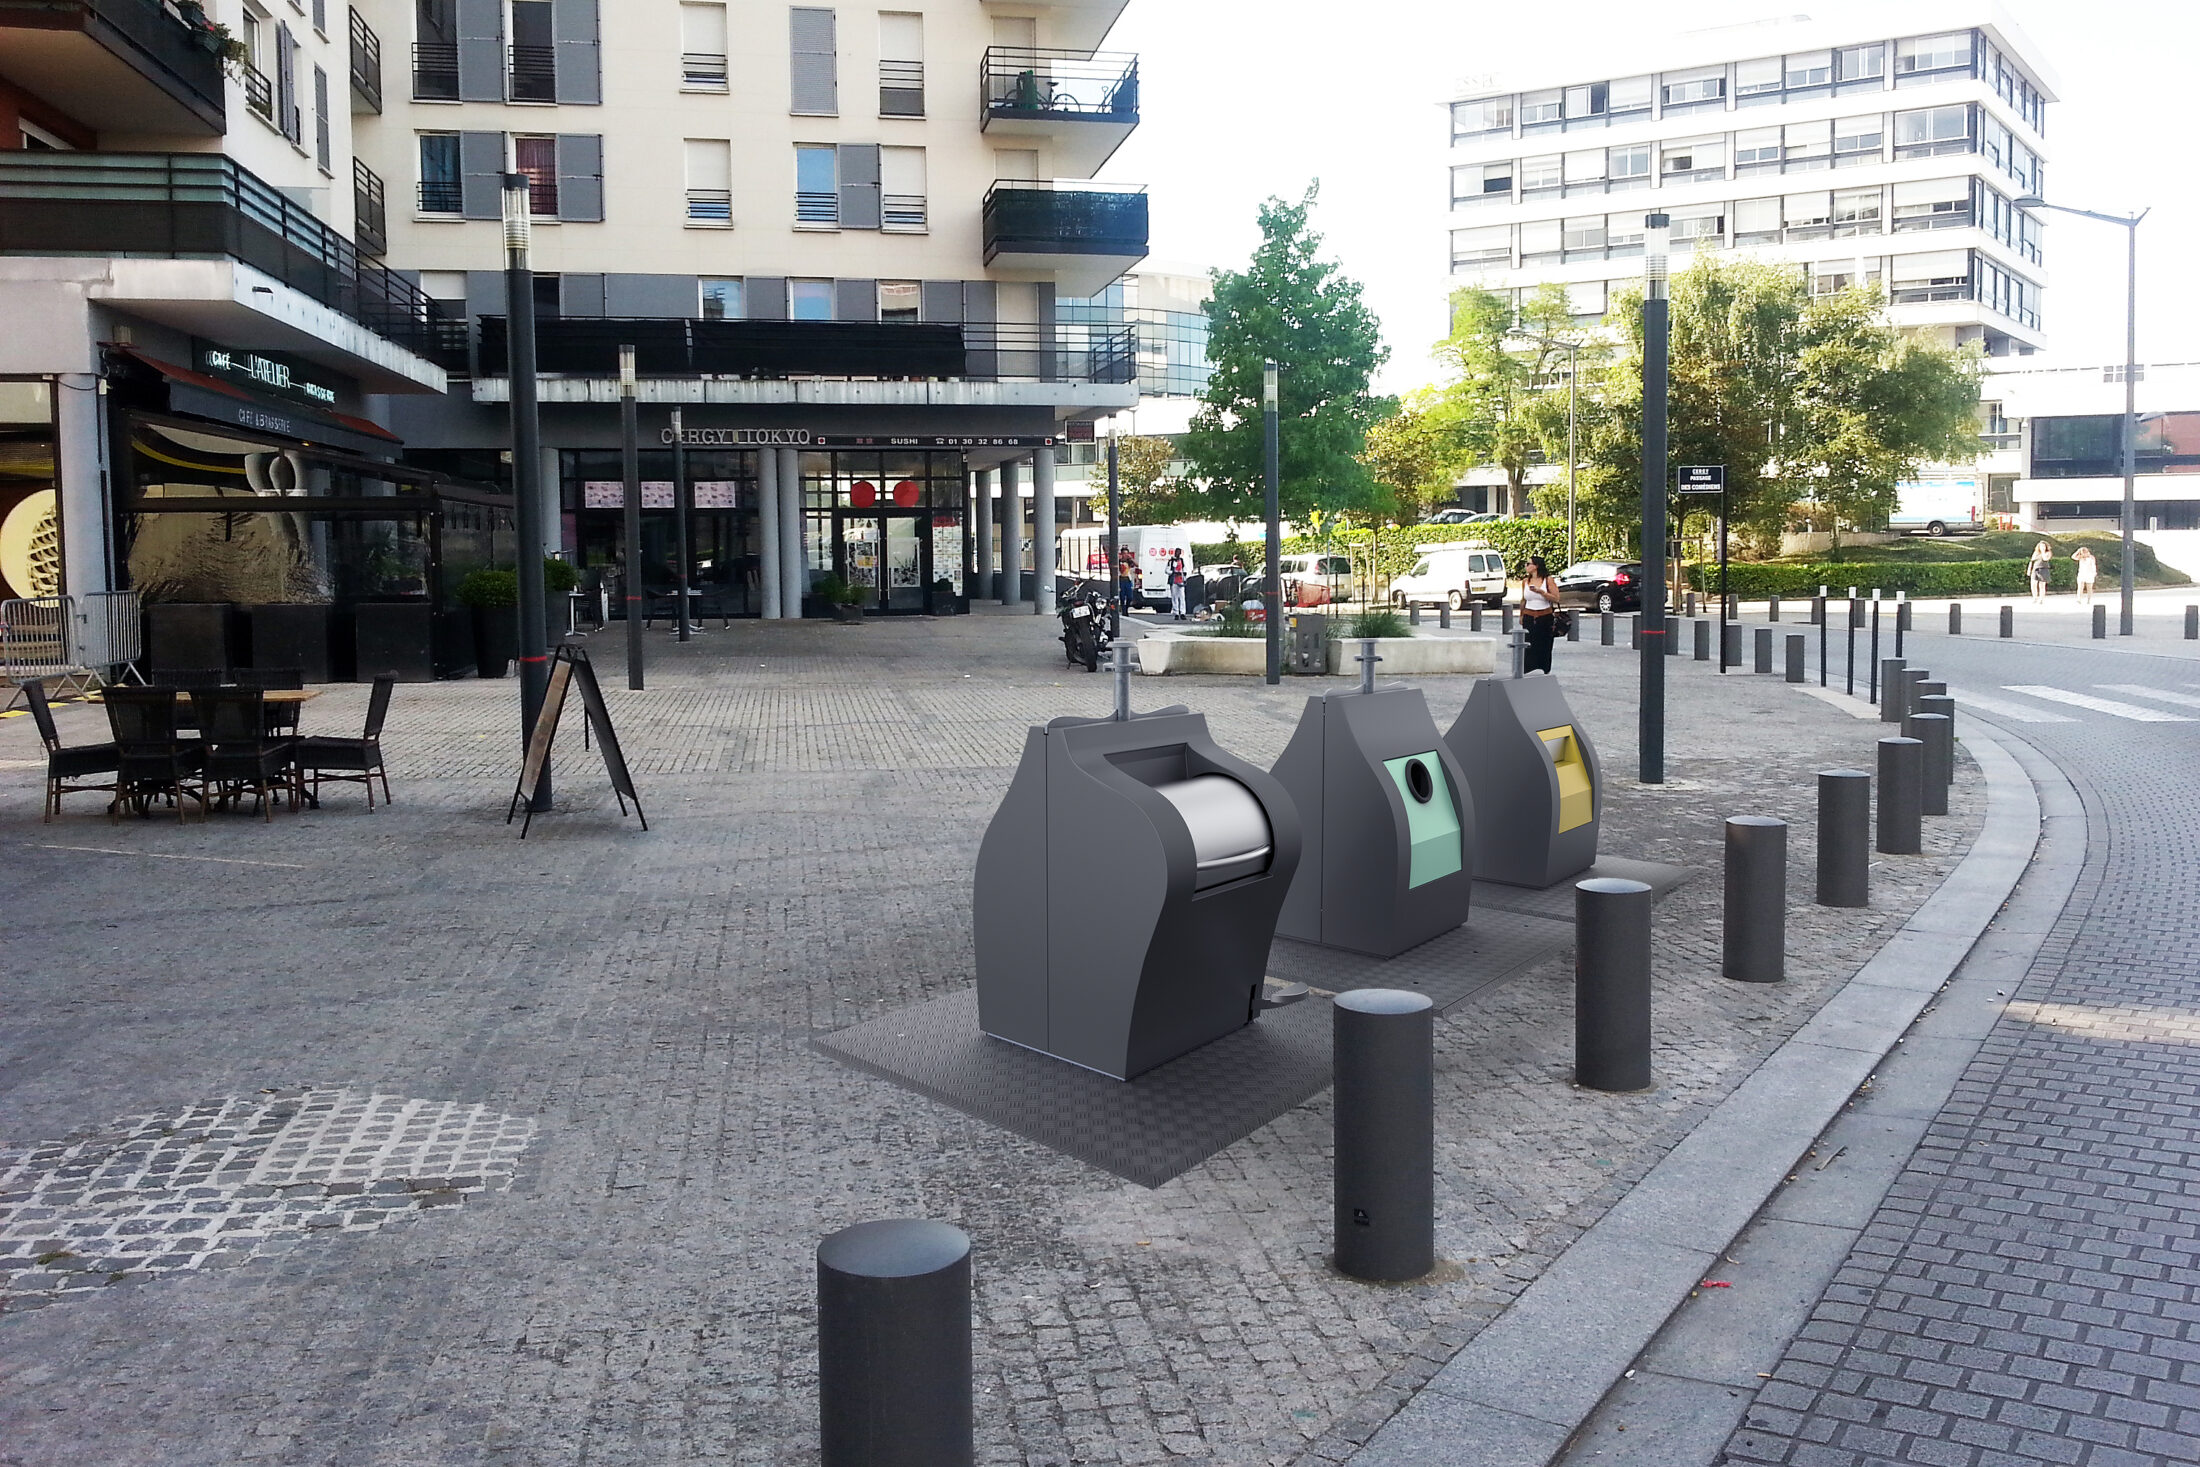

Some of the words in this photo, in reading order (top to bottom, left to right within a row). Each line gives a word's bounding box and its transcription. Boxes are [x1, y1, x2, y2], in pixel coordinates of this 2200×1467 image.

[250, 354, 290, 389] L'ATELIER
[660, 427, 726, 444] CERGY
[744, 427, 811, 444] TOKYO
[890, 437, 918, 445] SUSHI
